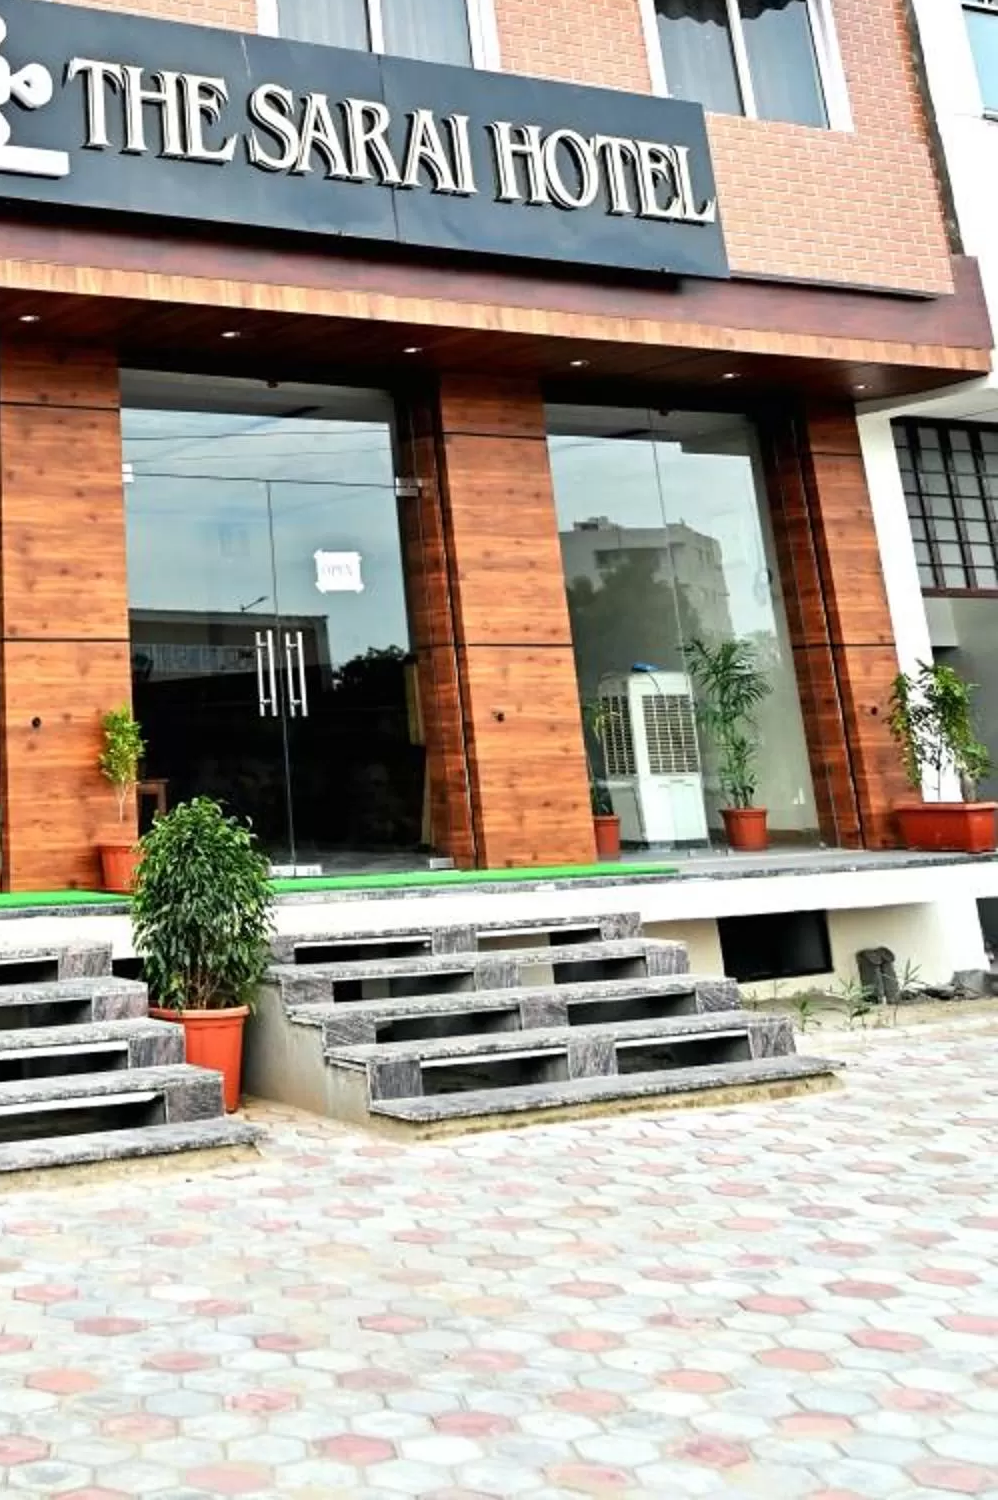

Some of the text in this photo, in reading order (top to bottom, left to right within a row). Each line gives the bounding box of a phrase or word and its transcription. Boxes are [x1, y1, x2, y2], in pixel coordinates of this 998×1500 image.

[65, 56, 716, 225] THE SARAI HOTEL
[321, 563, 353, 577] OPEN
